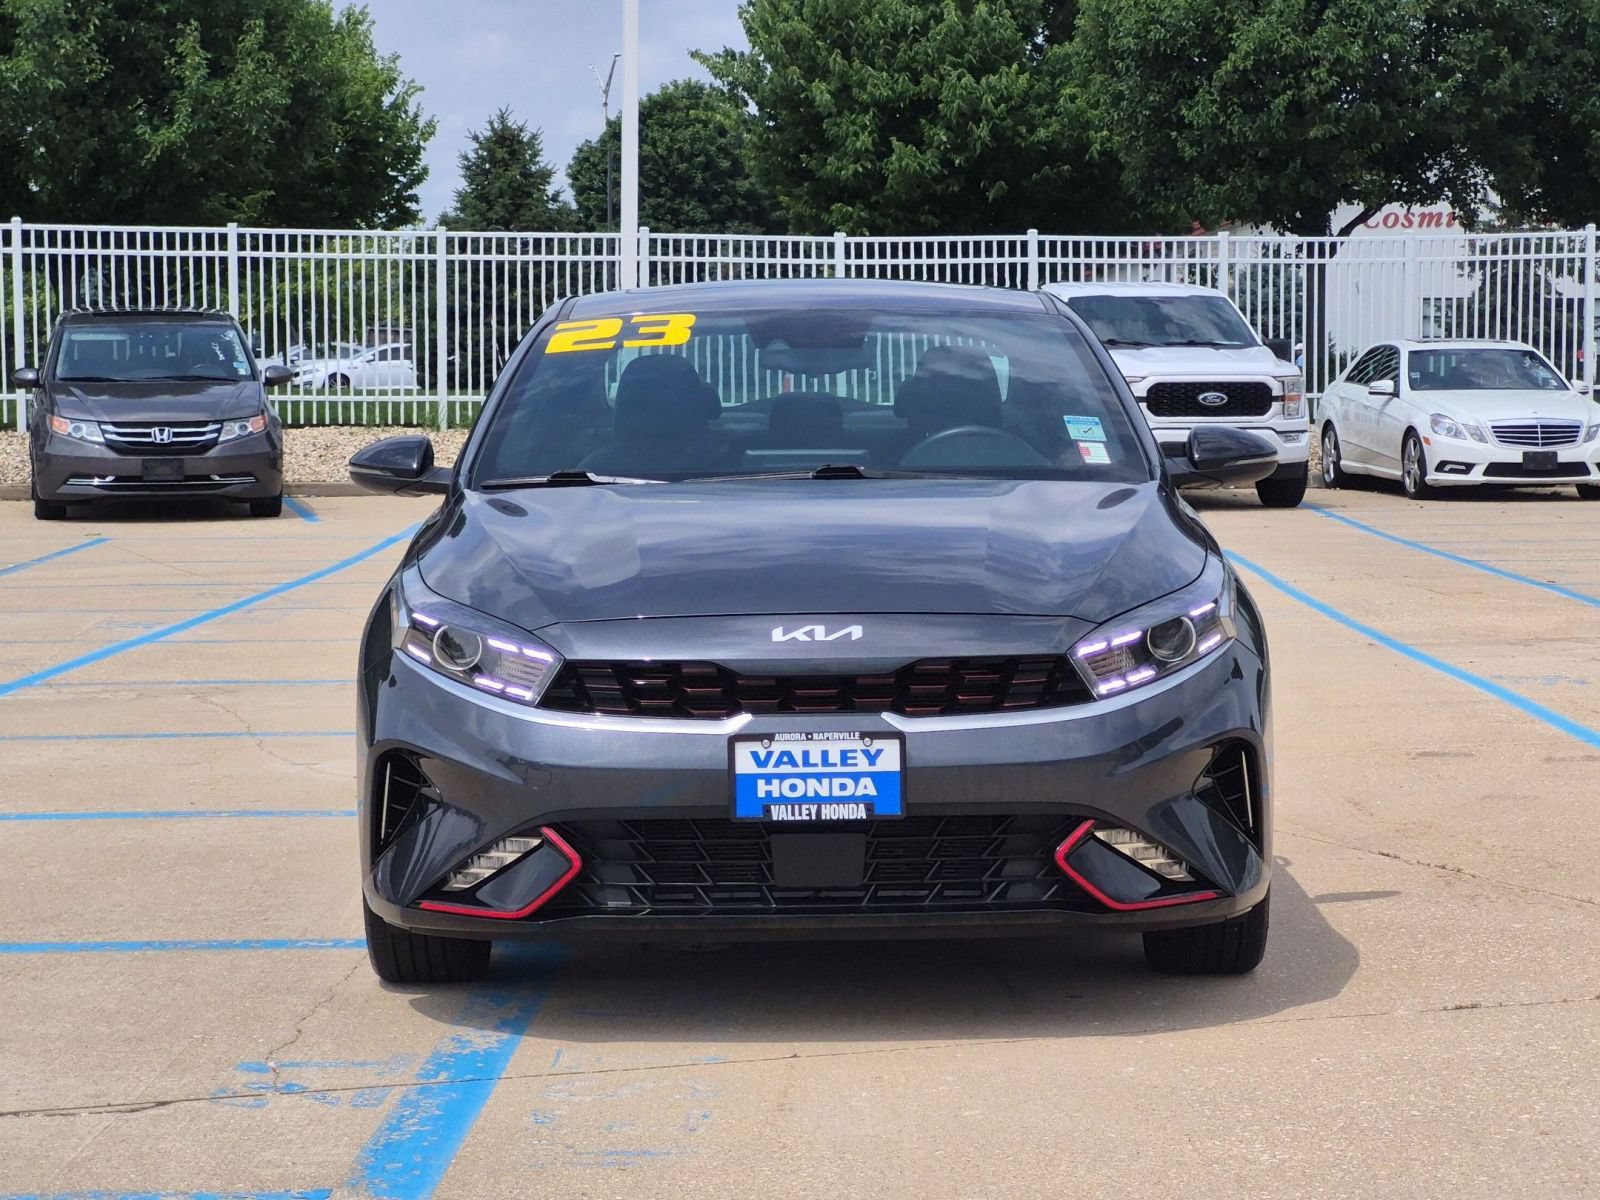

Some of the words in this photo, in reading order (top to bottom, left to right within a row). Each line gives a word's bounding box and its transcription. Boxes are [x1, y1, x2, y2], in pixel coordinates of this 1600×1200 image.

[544, 313, 697, 354] 23
[771, 625, 863, 642] KIA
[774, 733, 807, 741] AURORA
[812, 732, 860, 740] NAPERVILLE
[749, 748, 885, 769] VALLEY
[756, 777, 878, 798] HONDA
[770, 803, 818, 821] VALLEY
[821, 803, 867, 820] HONDA
